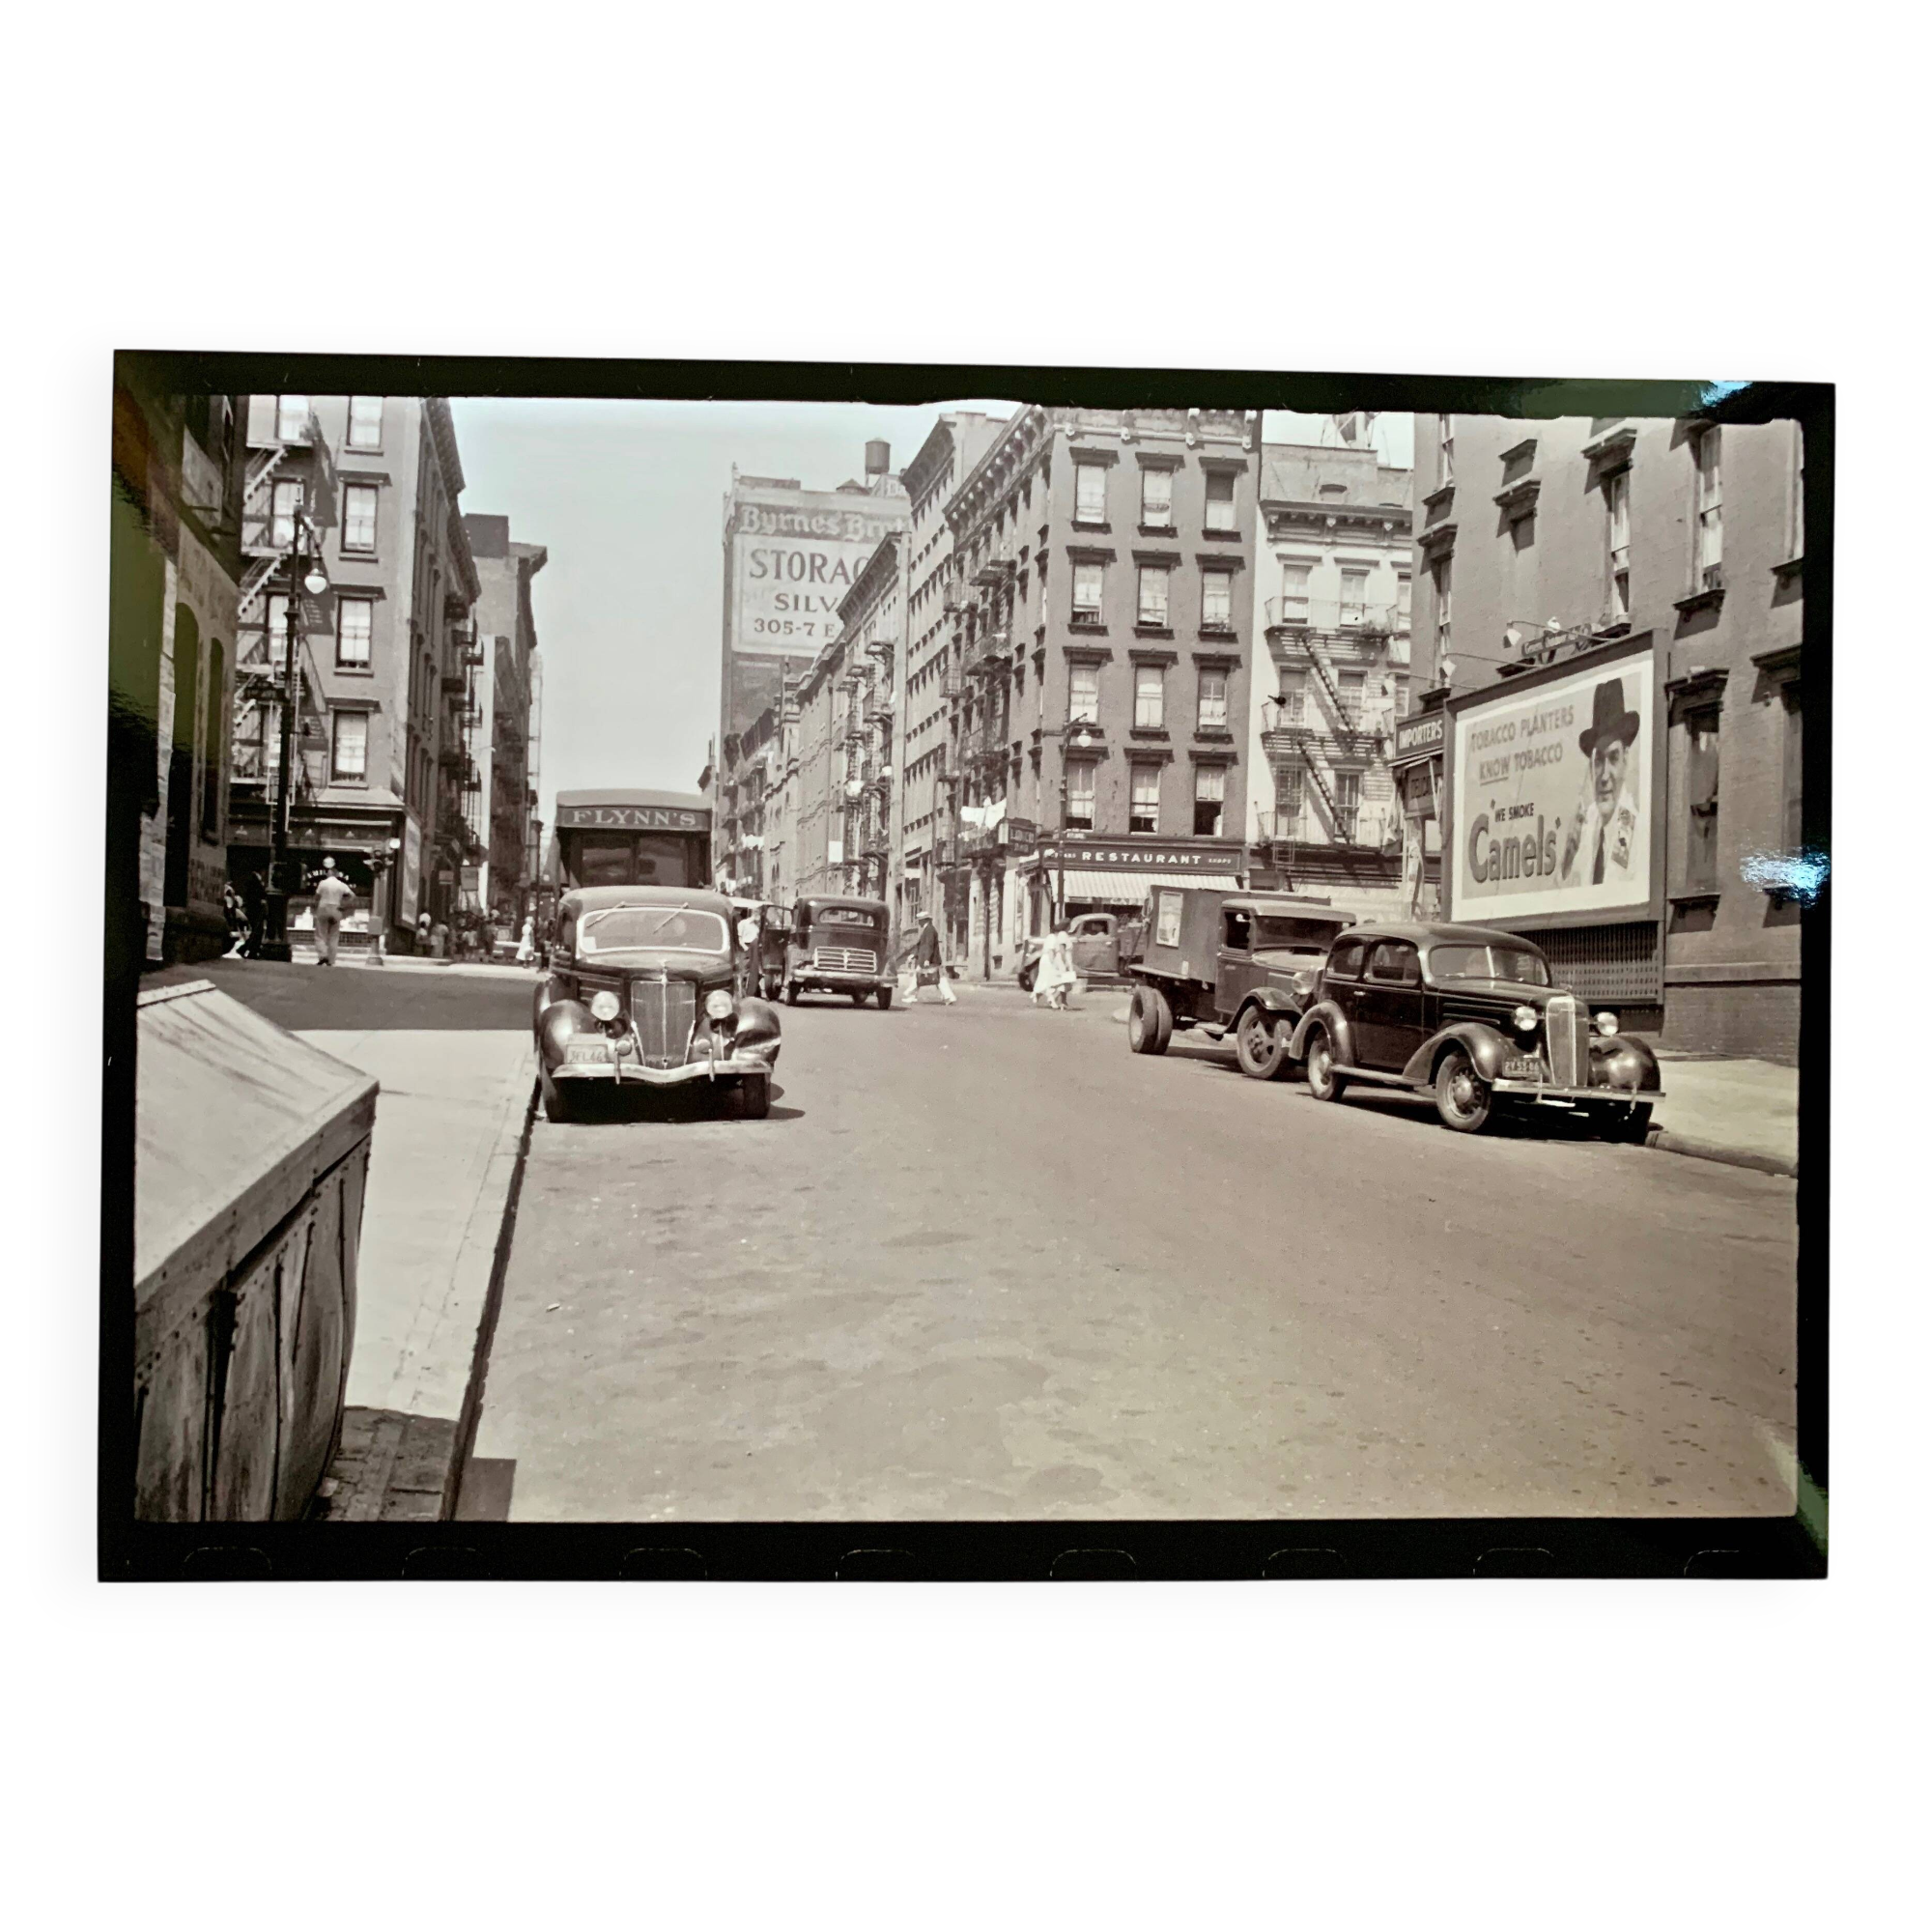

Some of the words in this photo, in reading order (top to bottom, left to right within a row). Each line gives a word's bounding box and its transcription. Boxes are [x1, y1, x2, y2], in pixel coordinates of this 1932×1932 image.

[753, 617, 816, 637] 305-7
[1399, 719, 1443, 750] IMPORTERS
[1471, 722, 1516, 753] TOBACCO
[1520, 704, 1575, 738] PLANTERS
[1480, 754, 1510, 780] KNOW
[1514, 742, 1563, 772] TOBACCO
[572, 809, 696, 826] FLYNN'S
[1509, 803, 1534, 820] SMOKE
[1082, 852, 1201, 865] RESTAURANT
